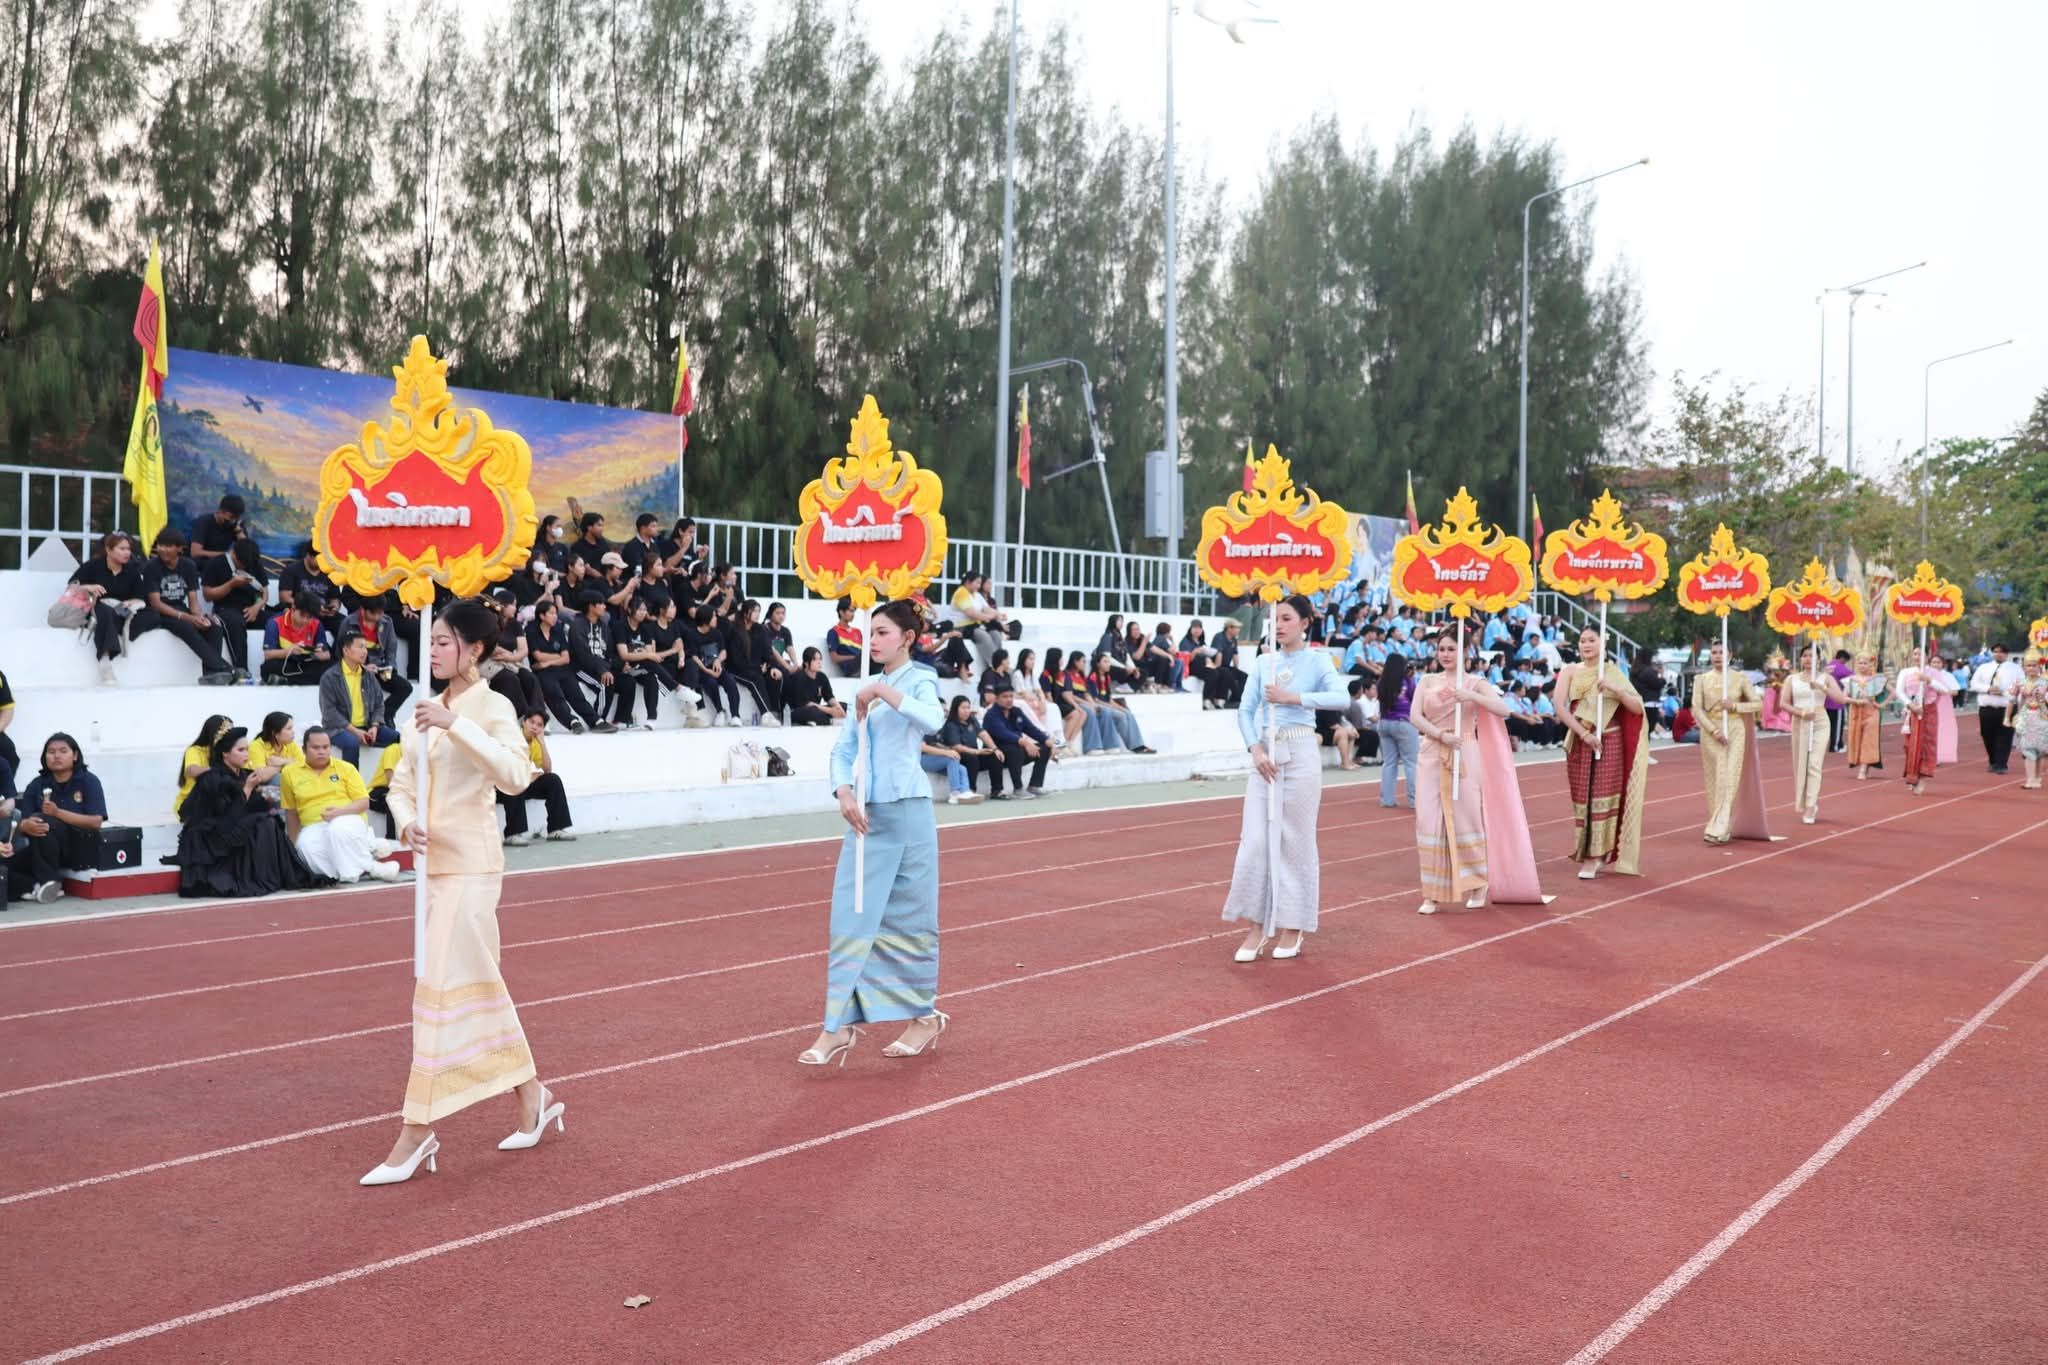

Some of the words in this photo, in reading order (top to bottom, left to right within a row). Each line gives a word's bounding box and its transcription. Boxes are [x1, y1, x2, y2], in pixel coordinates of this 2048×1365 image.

[1566, 549, 1644, 570] ไทยจักรพรรดิ
